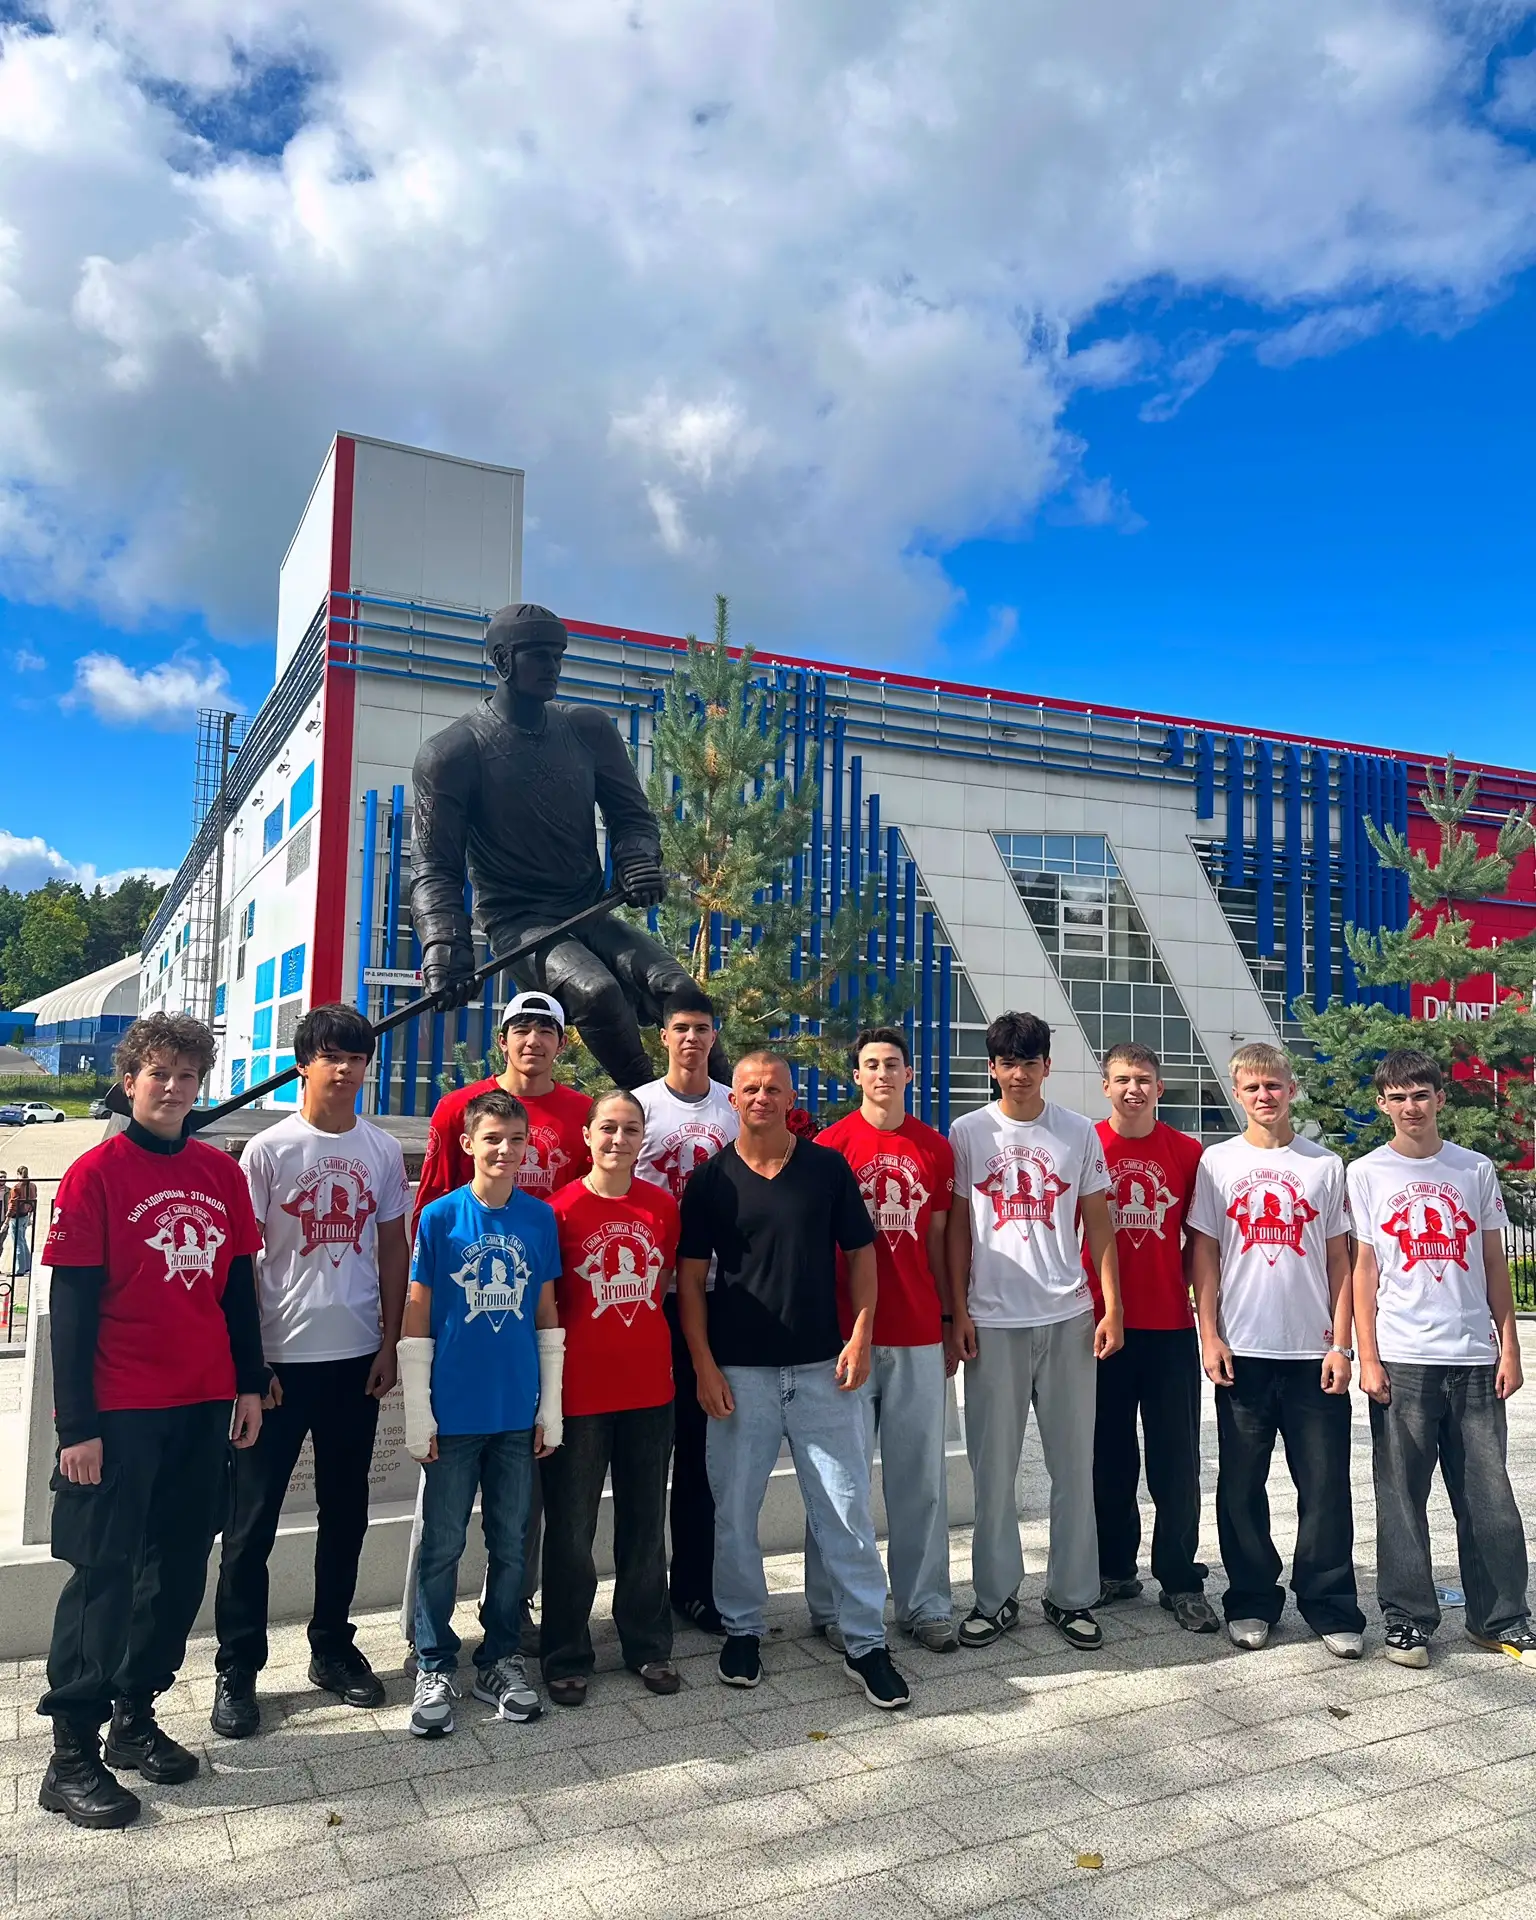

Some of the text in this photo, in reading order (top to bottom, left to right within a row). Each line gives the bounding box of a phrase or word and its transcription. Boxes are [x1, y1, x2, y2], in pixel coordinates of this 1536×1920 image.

[127, 1202, 149, 1223] БЫТЬ
[145, 1190, 185, 1207] ЗДОРОВЫМ
[191, 1191, 205, 1201] ЭТО
[311, 1220, 357, 1239] ЯРОПОЛ
[374, 1462, 401, 1473] СССР
